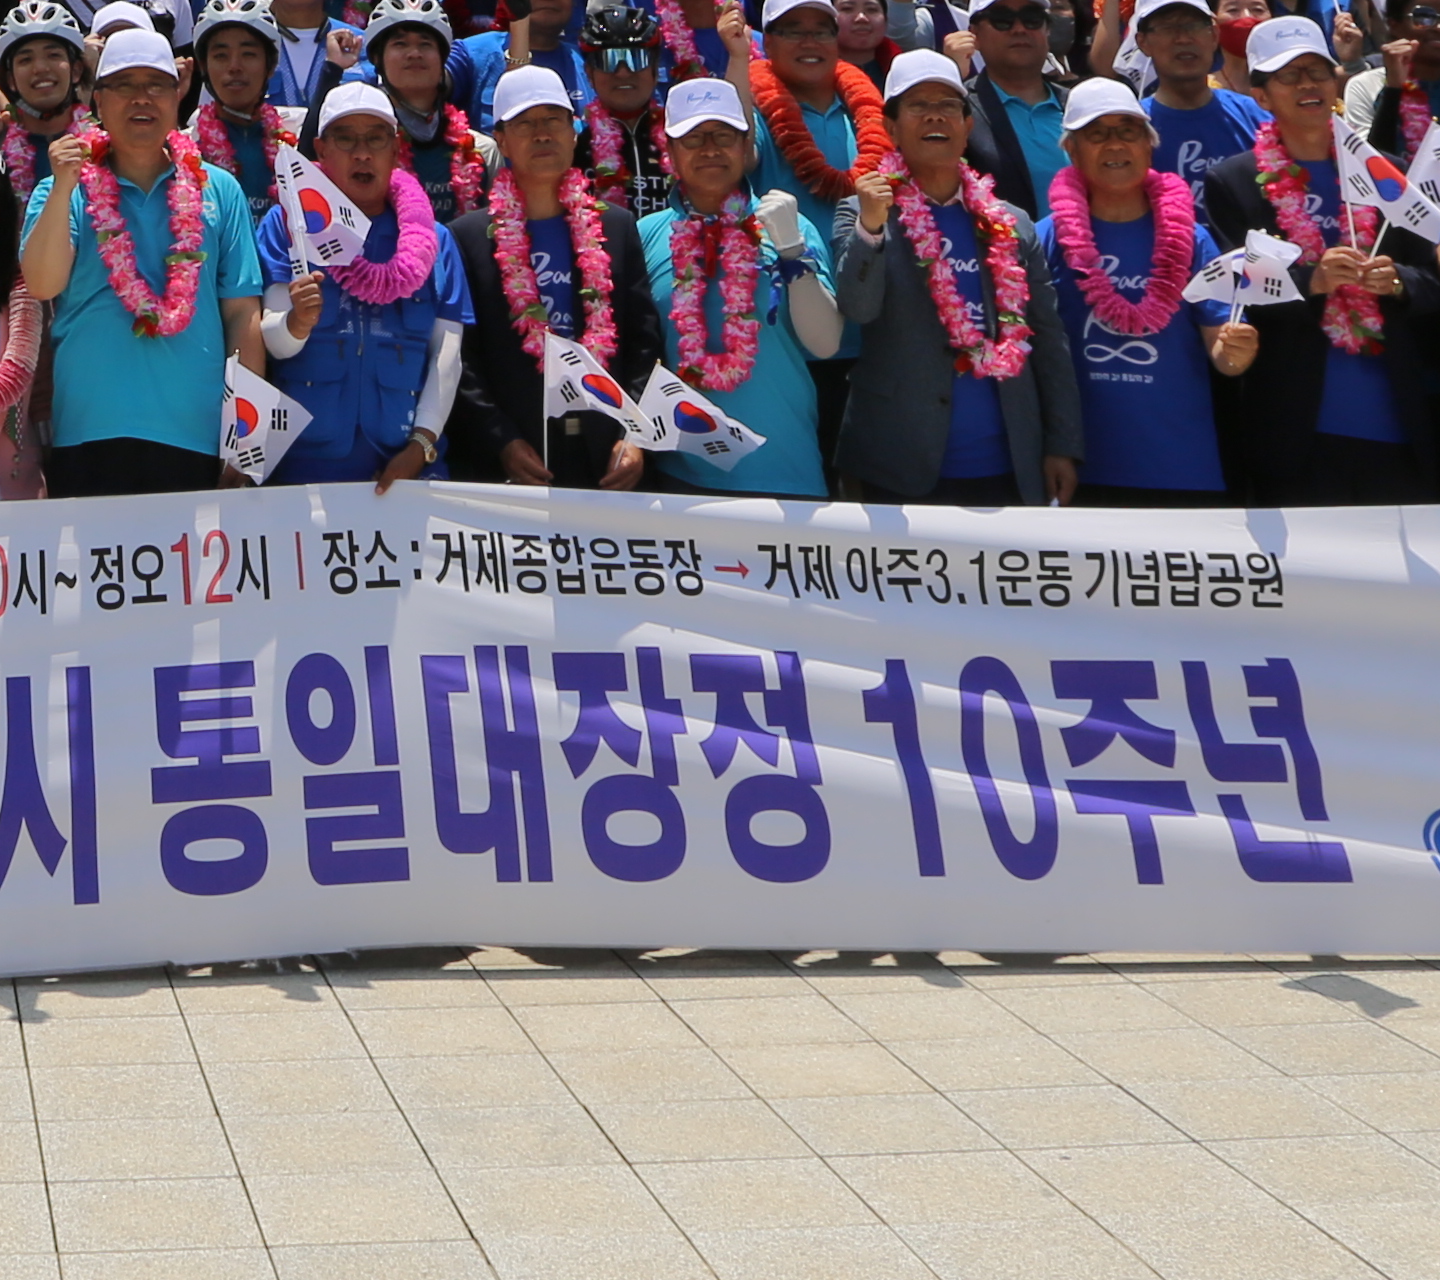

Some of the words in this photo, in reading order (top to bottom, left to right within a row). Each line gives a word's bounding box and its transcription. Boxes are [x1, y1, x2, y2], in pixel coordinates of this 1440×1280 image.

[433, 531, 705, 597] 거제종합운동장
[756, 542, 838, 601] 거제
[845, 544, 1074, 608] 아주3.1운동
[1083, 549, 1285, 610] 기념탑공원
[150, 643, 832, 897] 통일대장정
[862, 654, 1356, 886] 10주년
